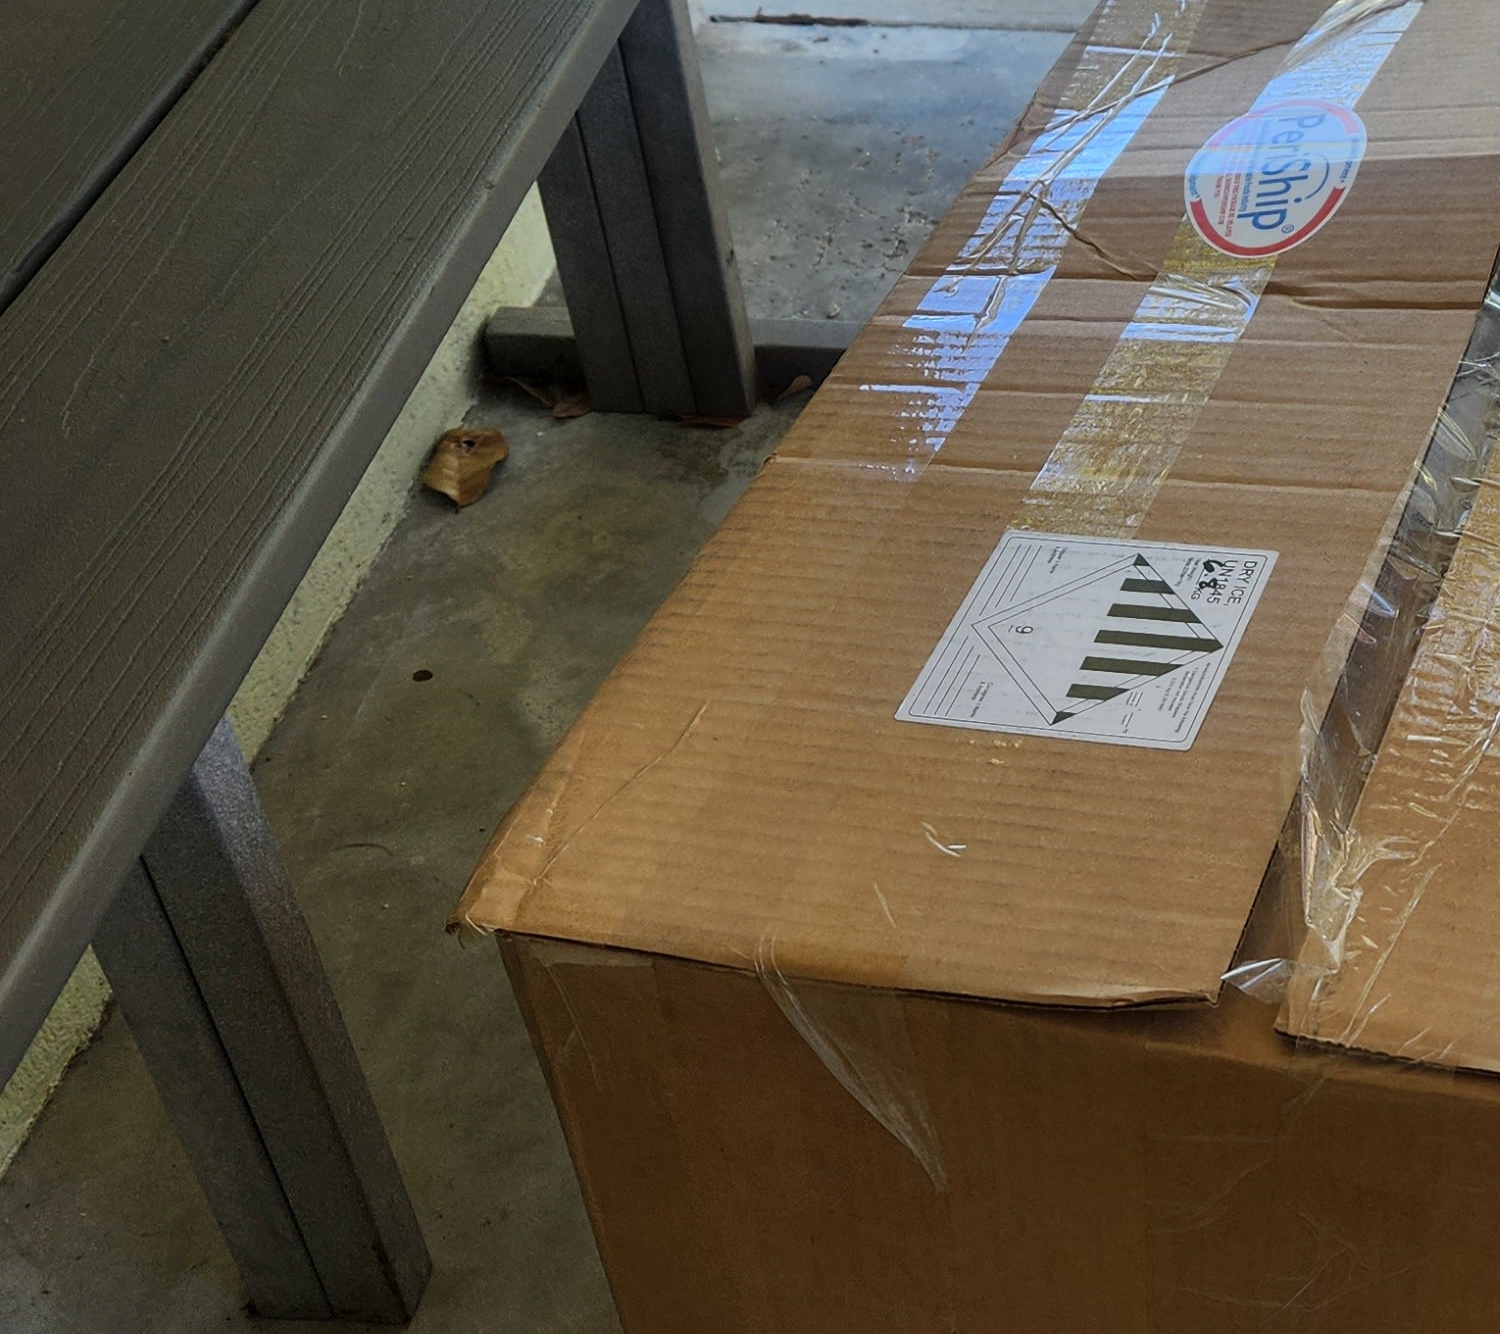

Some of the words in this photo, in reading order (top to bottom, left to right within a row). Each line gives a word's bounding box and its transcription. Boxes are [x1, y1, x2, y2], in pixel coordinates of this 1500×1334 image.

[1207, 560, 1238, 603] UN1845
[1238, 561, 1258, 584] DRY
[1190, 586, 1202, 600] KG
[1224, 586, 1246, 606] ICE,
[1014, 624, 1034, 635] 9
